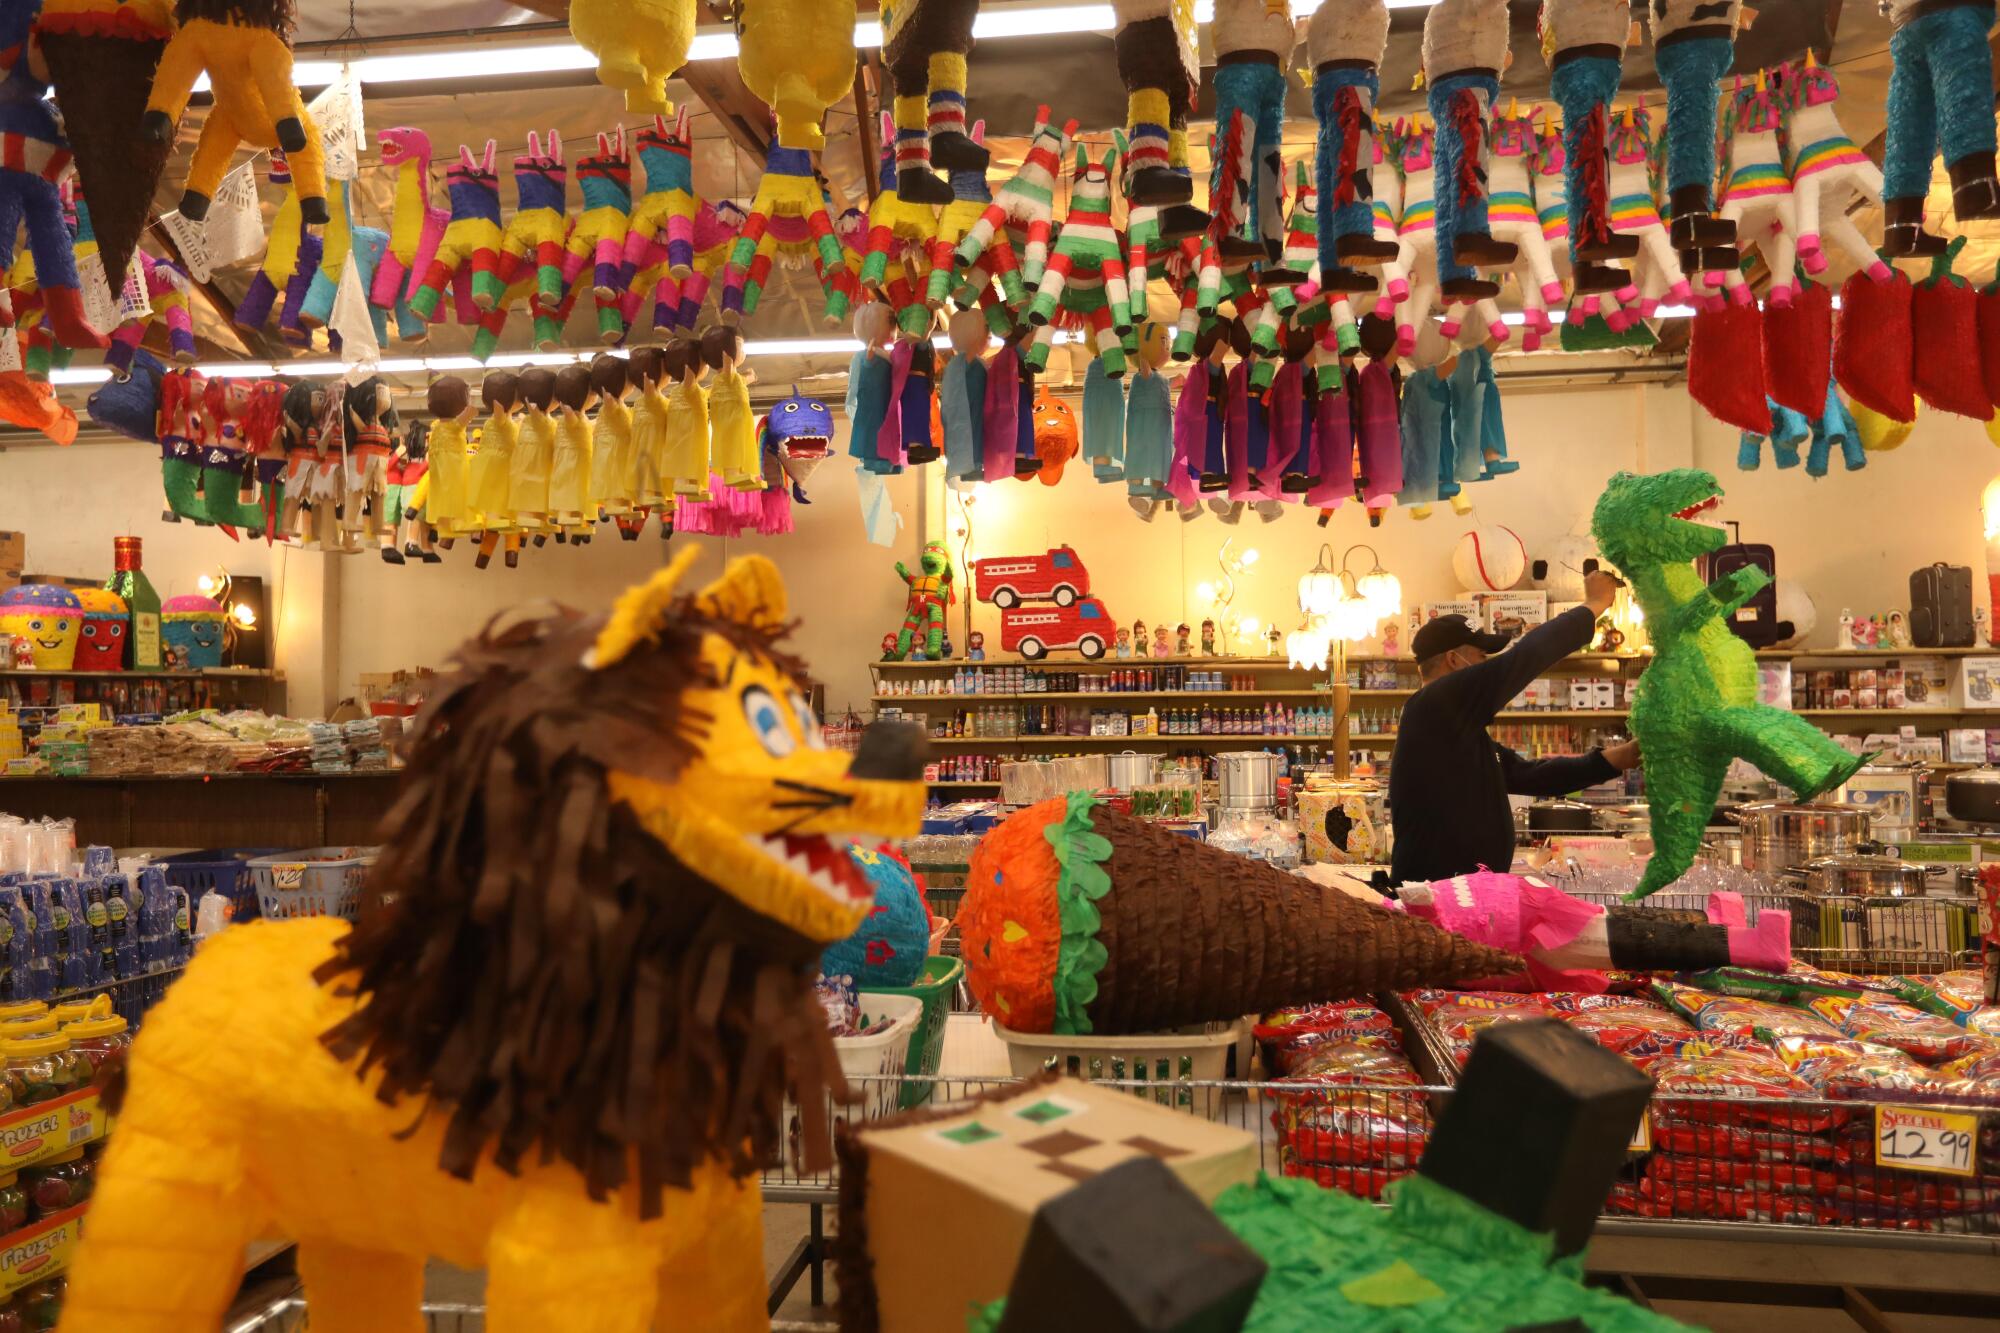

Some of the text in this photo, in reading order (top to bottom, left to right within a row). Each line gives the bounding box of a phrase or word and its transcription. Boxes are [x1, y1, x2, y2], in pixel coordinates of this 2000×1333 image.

[1882, 1108, 1945, 1130] SPECIAL
[1880, 1129, 1971, 1167] 12.99
[2, 1228, 67, 1272] FRUZEL
